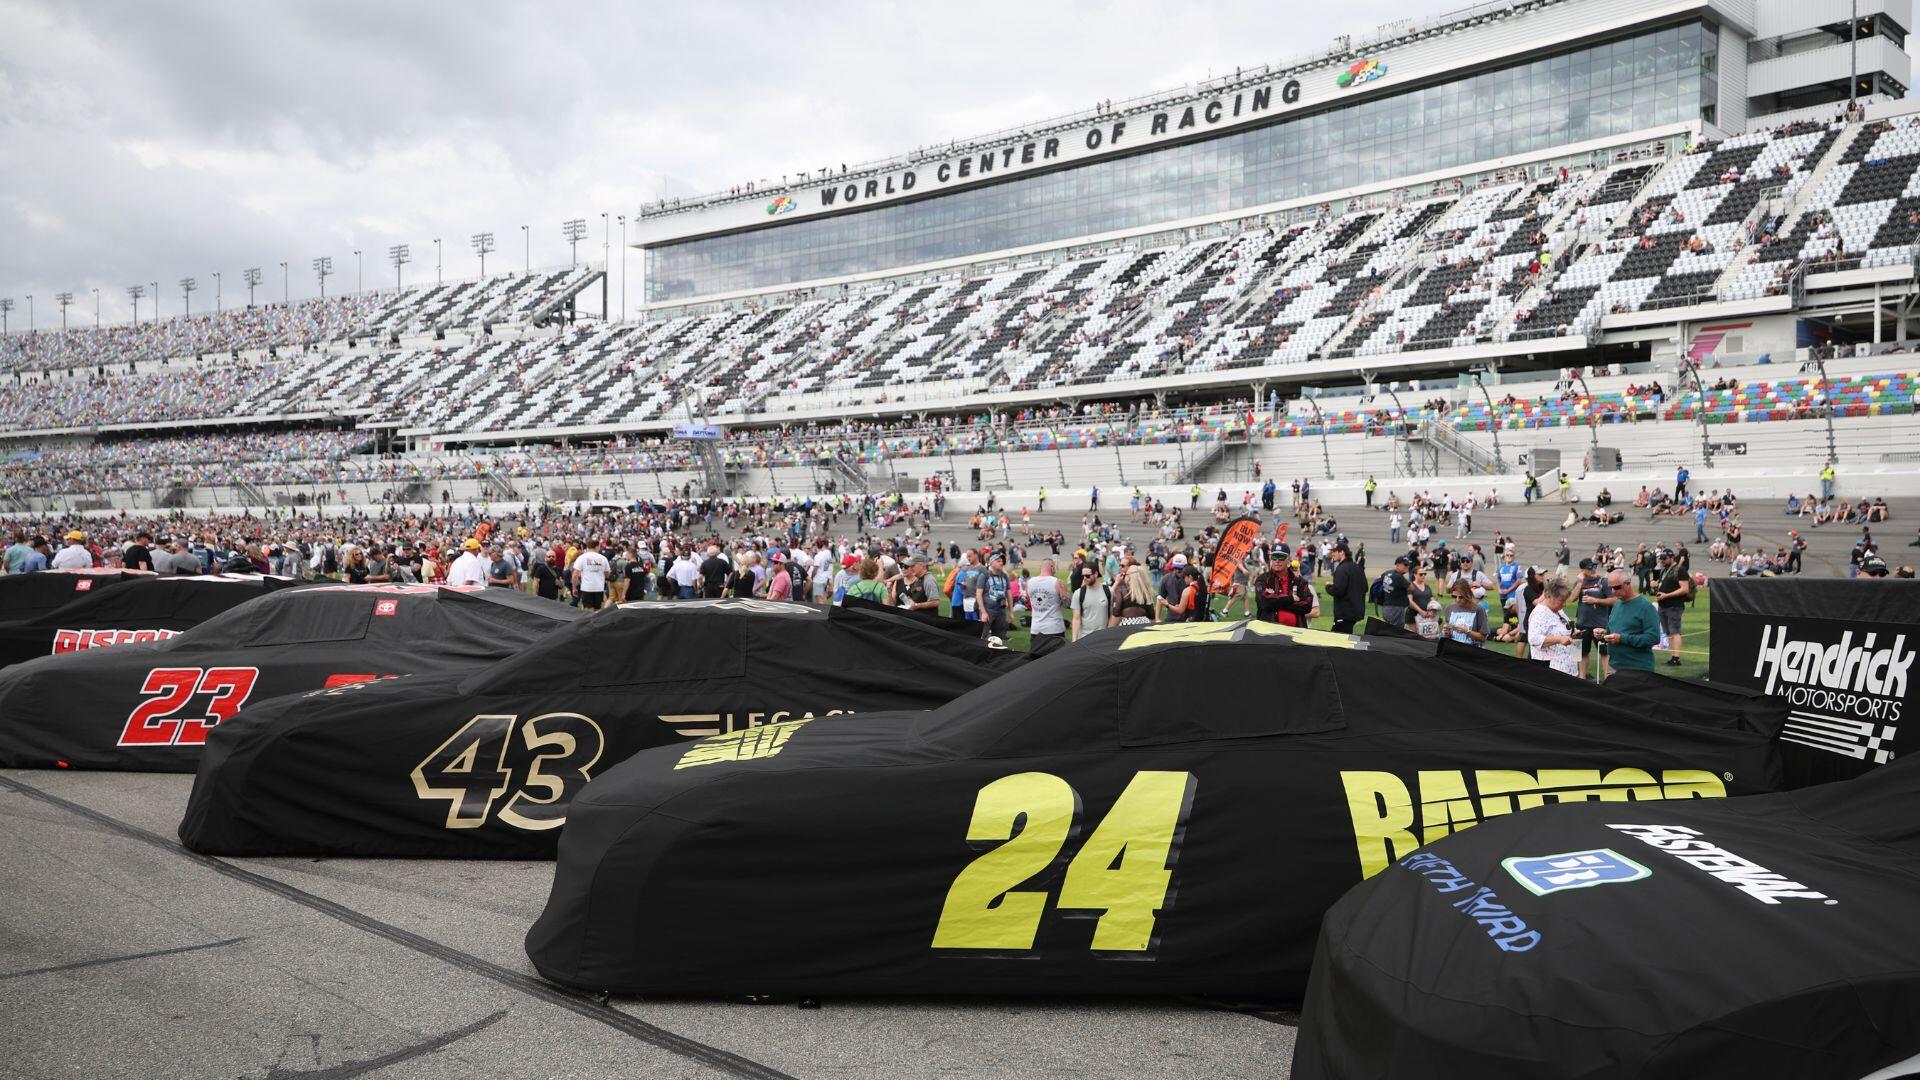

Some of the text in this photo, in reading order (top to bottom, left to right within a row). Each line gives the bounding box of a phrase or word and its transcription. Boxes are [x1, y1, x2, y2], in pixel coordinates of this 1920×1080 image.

[820, 79, 1301, 206] WORLD CENTER OF RACING
[1233, 531, 1251, 545] NOW
[1239, 524, 1254, 537] BUY
[1753, 624, 1916, 698] Hendrick
[116, 666, 260, 747] 23
[724, 709, 856, 734] LEG
[1777, 685, 1903, 721] MOTORSPORTS
[410, 711, 605, 831] 43
[931, 769, 1197, 958] 24
[1339, 767, 1728, 882] RAP
[1604, 823, 1829, 905] FASTENAL
[1400, 852, 1543, 952] FIFTH THIRD
